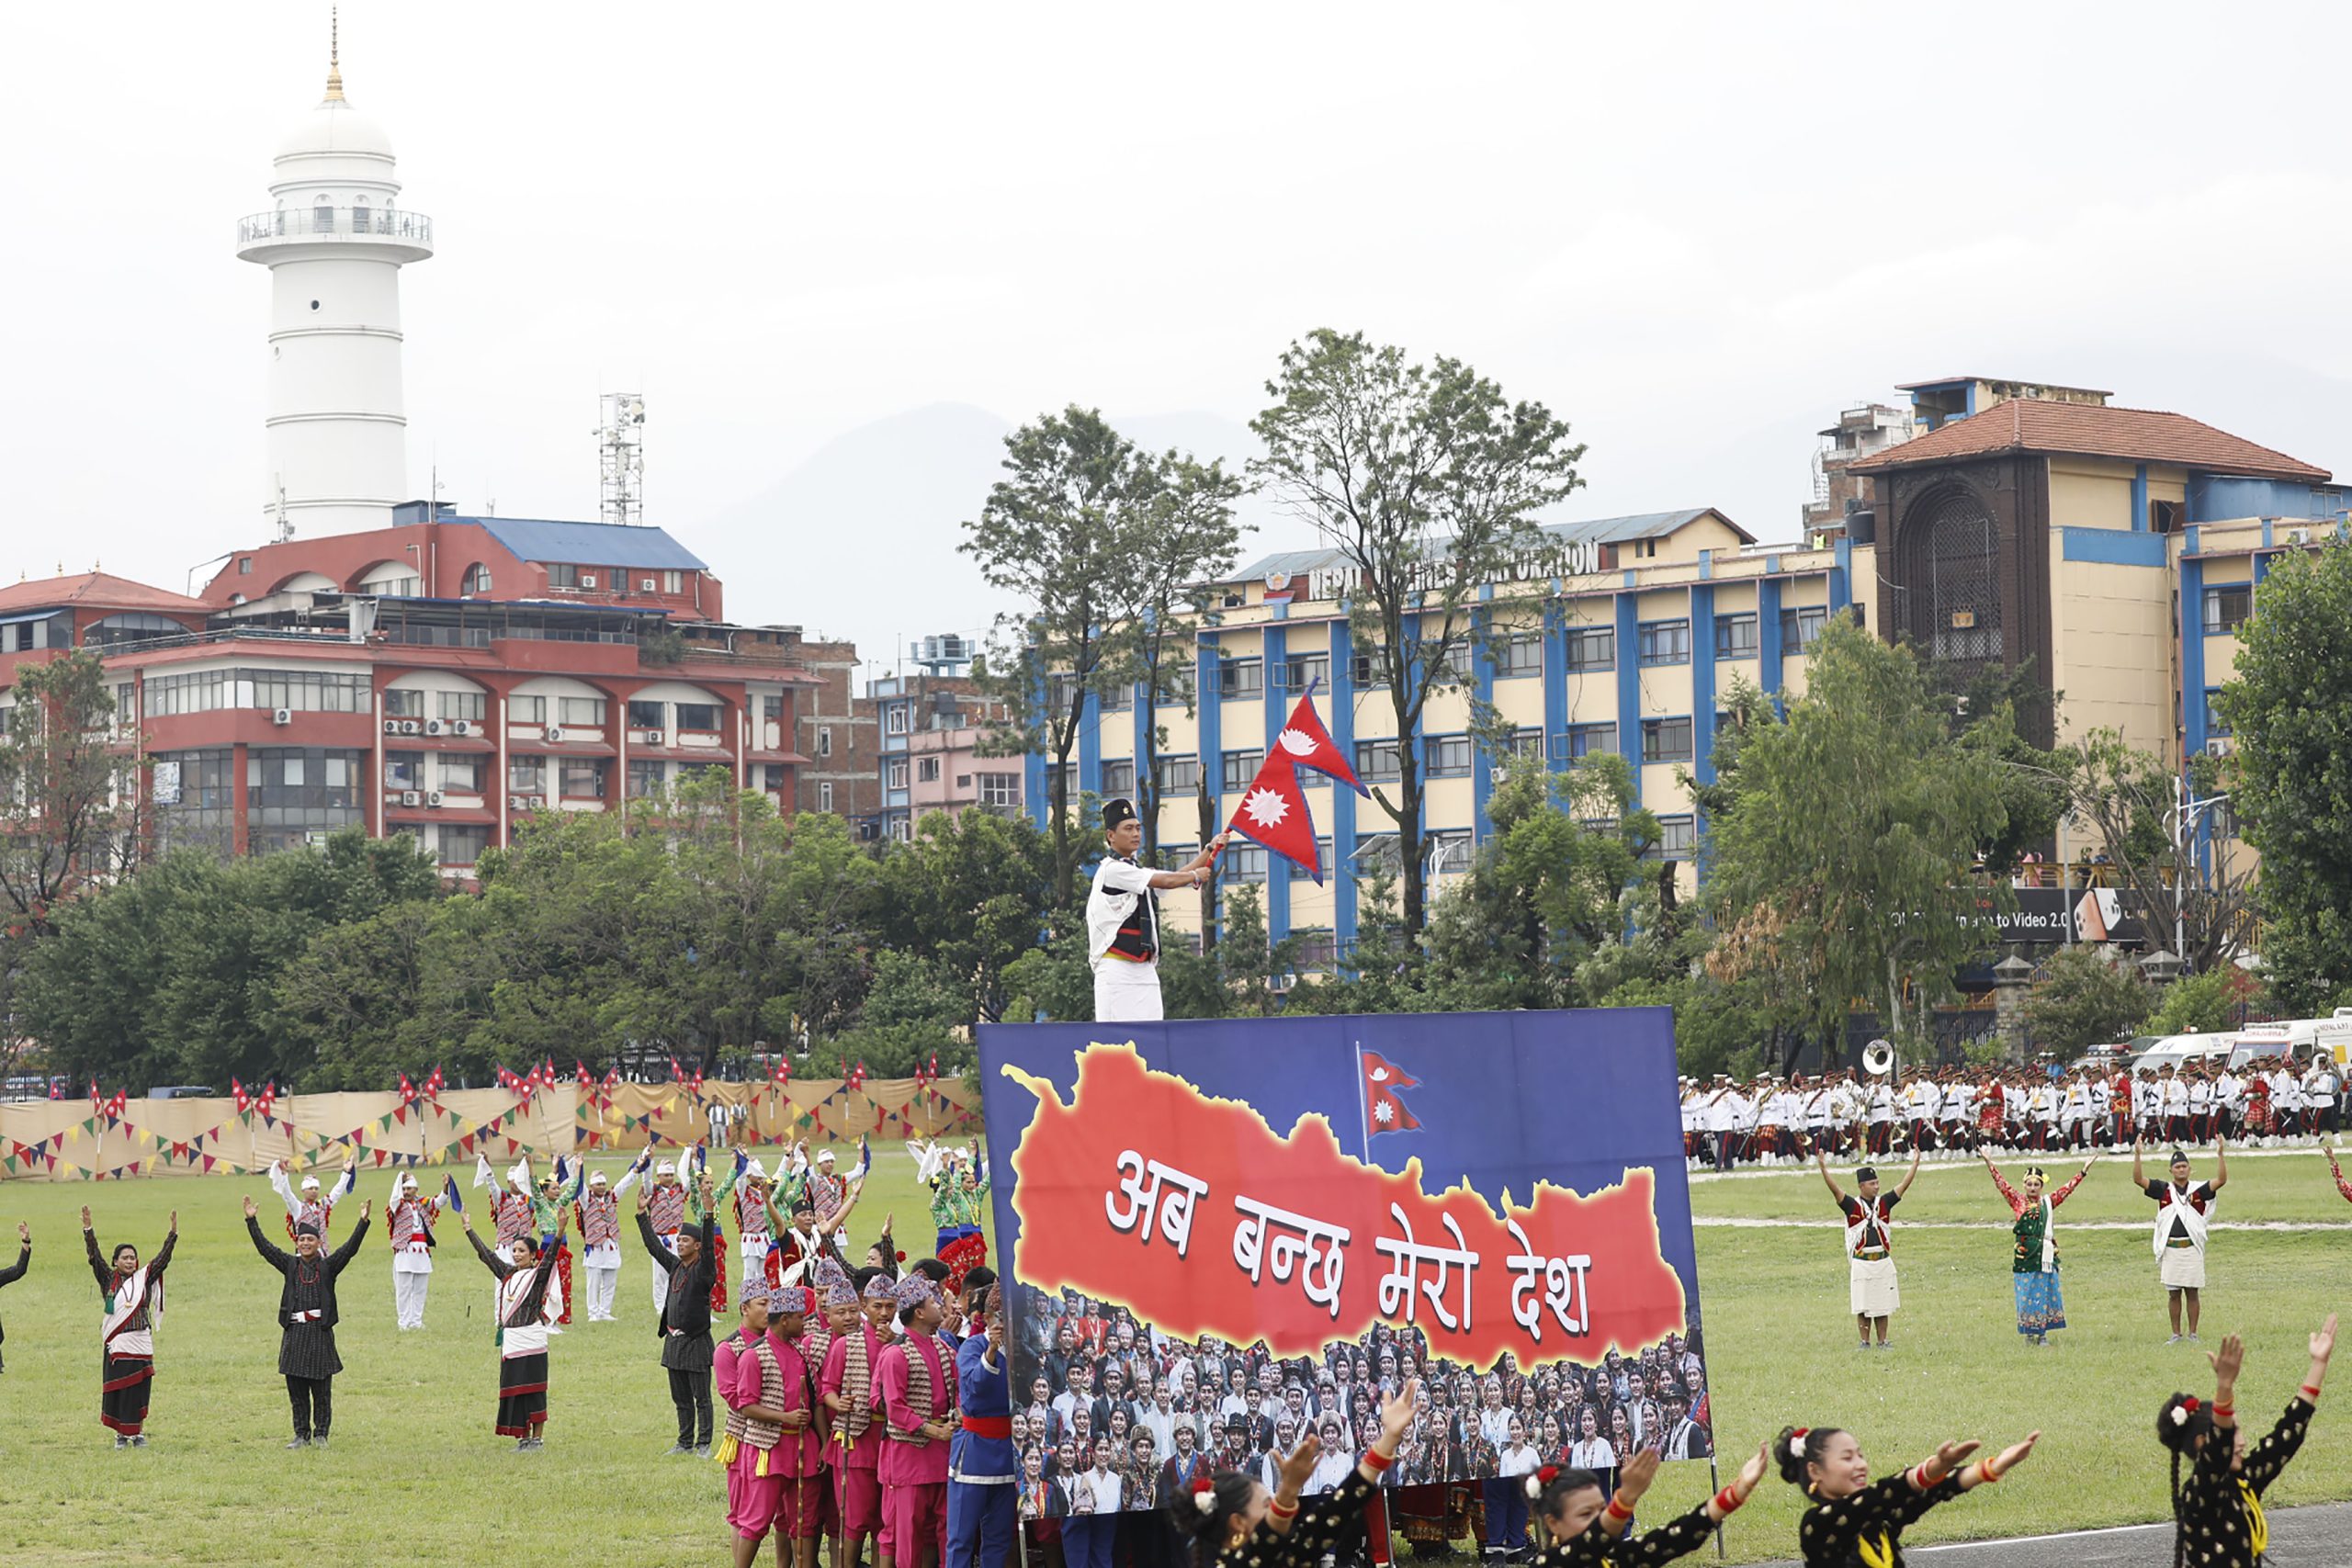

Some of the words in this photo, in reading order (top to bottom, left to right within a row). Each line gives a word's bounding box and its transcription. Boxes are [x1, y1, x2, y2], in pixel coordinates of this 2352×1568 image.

[1996, 912, 2010, 928] to
[2012, 911, 2048, 928] Video
[2050, 911, 2067, 928] 2.0
[1105, 1149, 1209, 1256] अब
[1233, 1194, 1351, 1316] बन्छ
[1374, 1201, 1480, 1330] मेरो
[1506, 1217, 1591, 1341] देश
